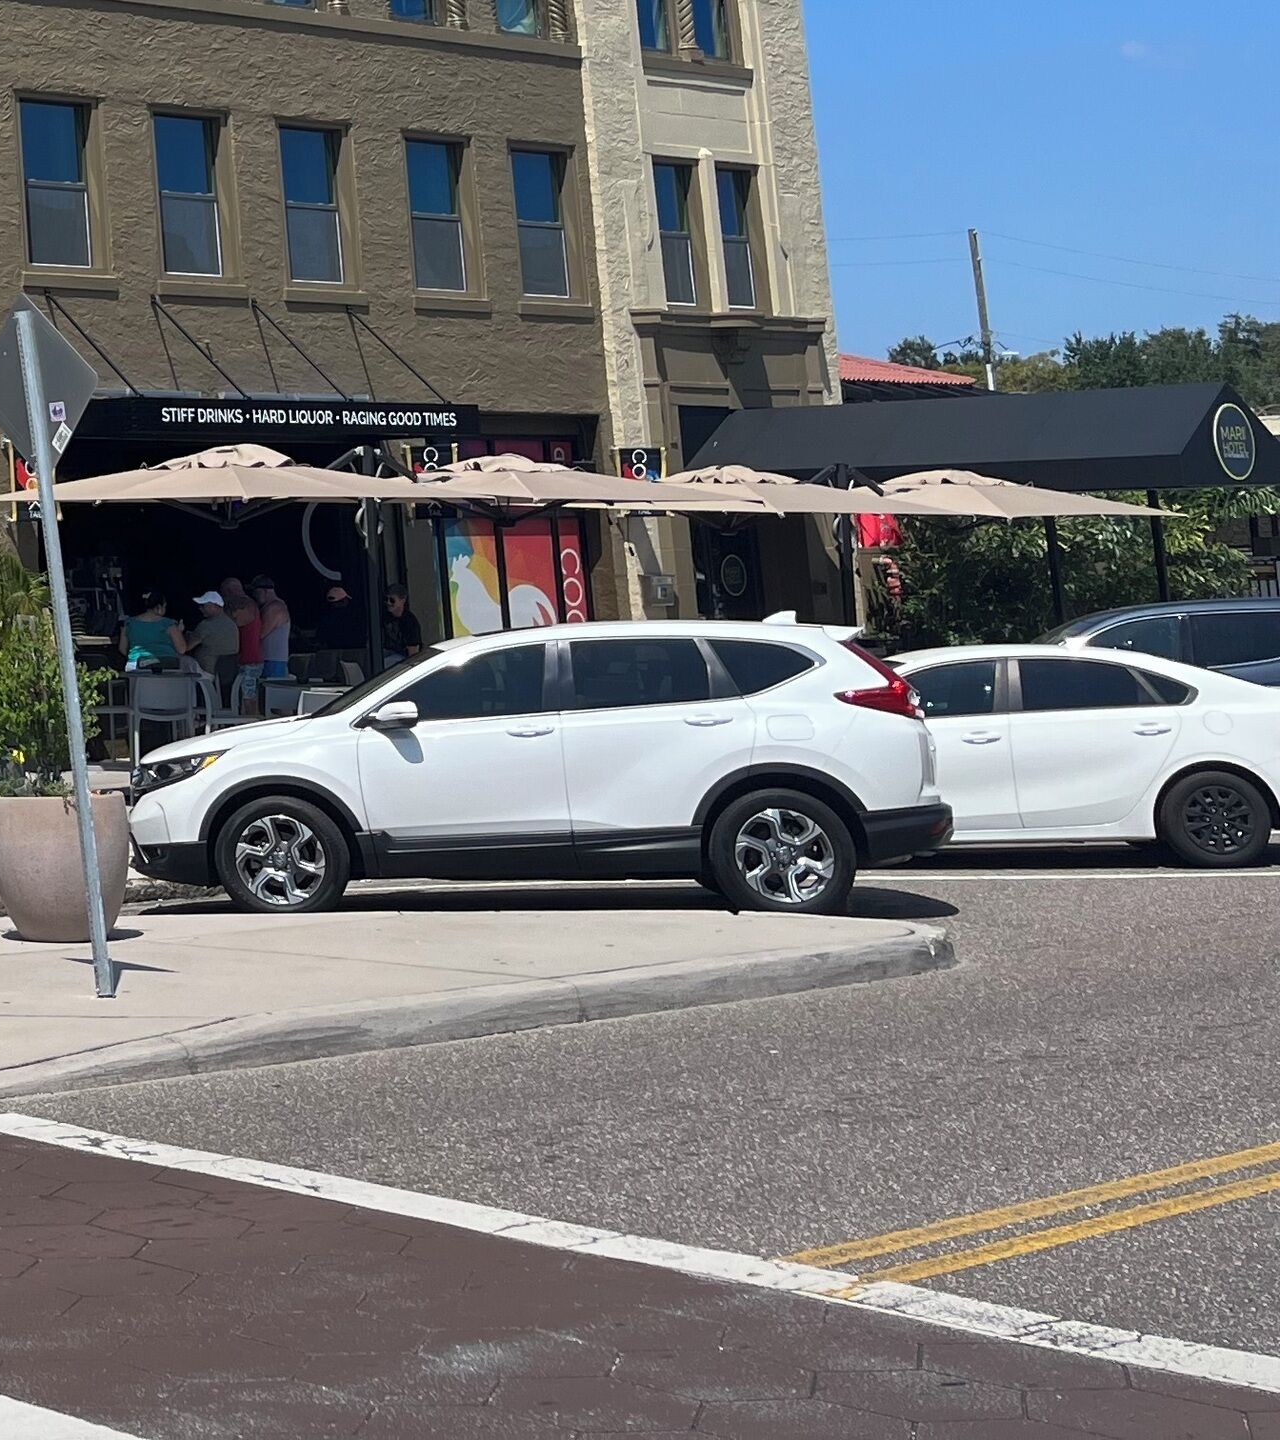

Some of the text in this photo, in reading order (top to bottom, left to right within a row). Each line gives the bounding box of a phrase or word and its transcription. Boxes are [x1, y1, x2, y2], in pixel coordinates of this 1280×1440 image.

[161, 407, 457, 427] STIFF DRINKS HARD LIQUOR RAGING GOOD TIMES
